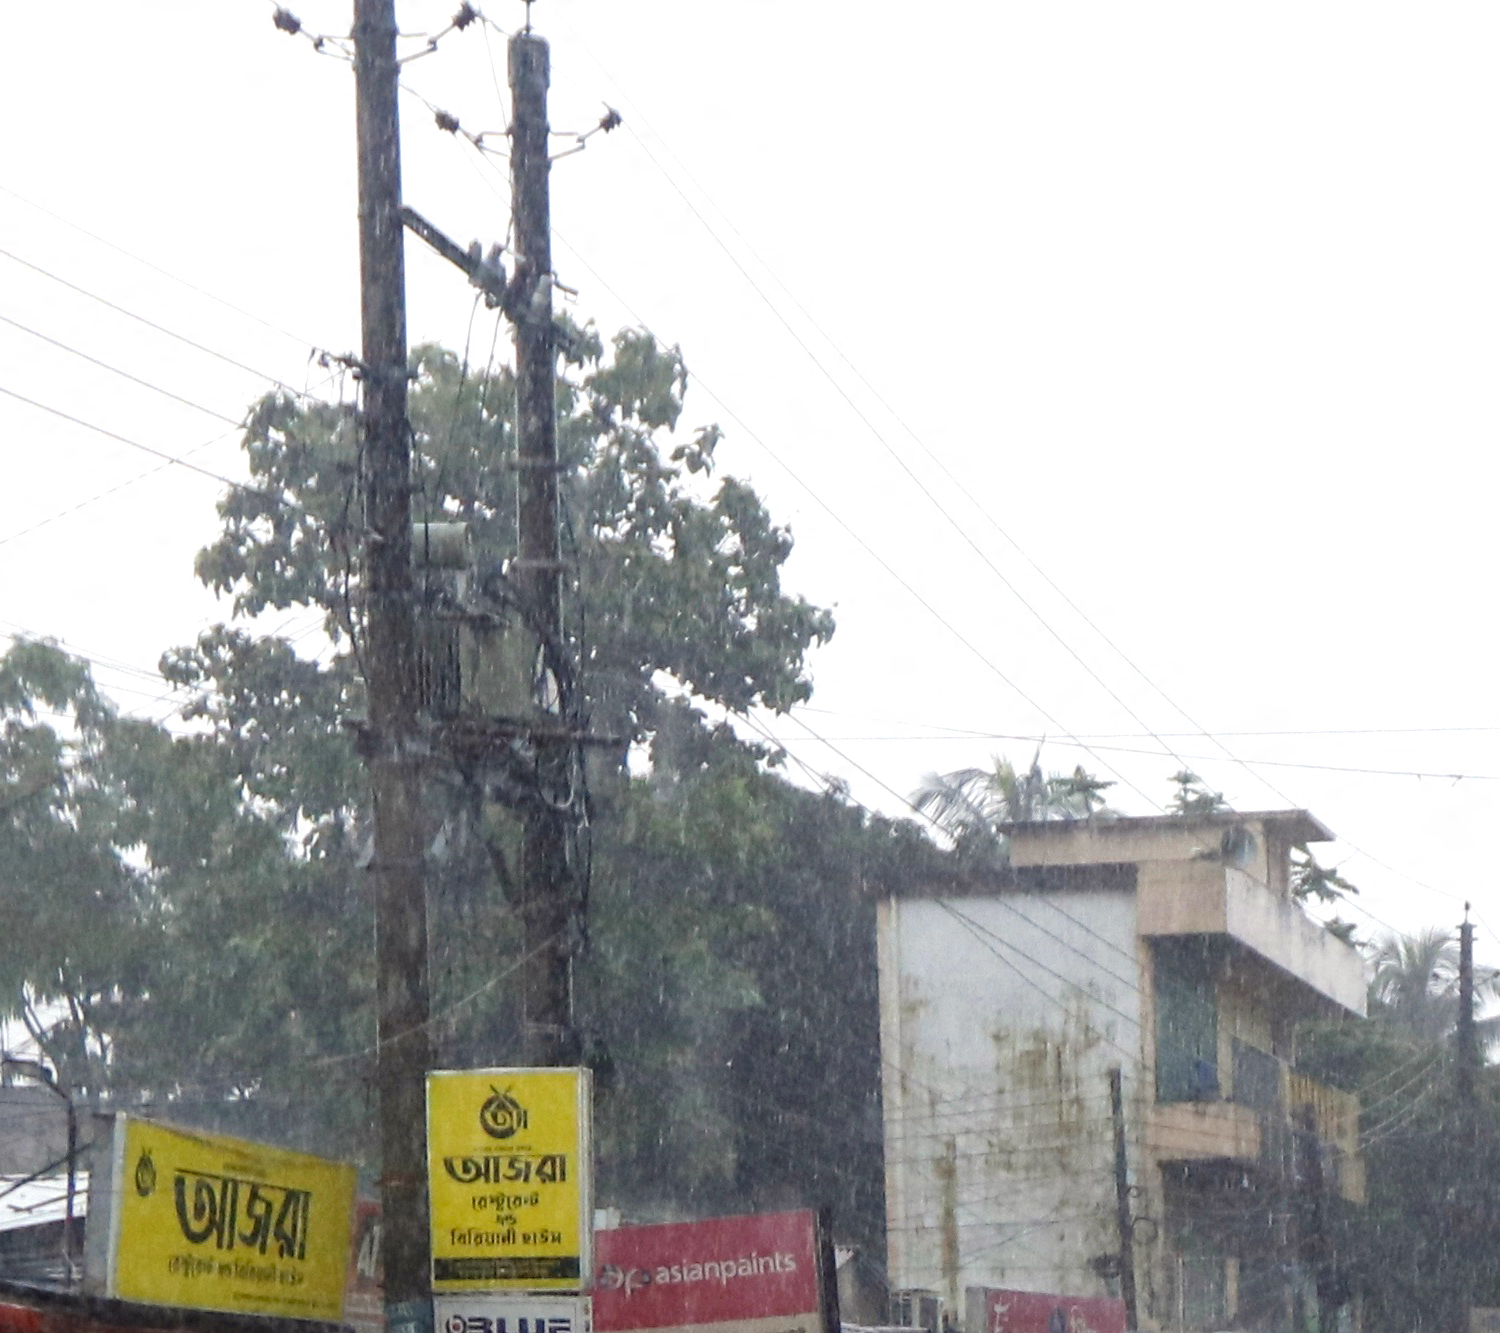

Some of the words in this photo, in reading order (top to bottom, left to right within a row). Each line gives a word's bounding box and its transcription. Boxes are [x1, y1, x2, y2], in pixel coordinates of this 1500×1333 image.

[443, 1154, 567, 1184] আজরা
[173, 1168, 314, 1262] আজরা
[654, 1251, 797, 1285] asianpaints
